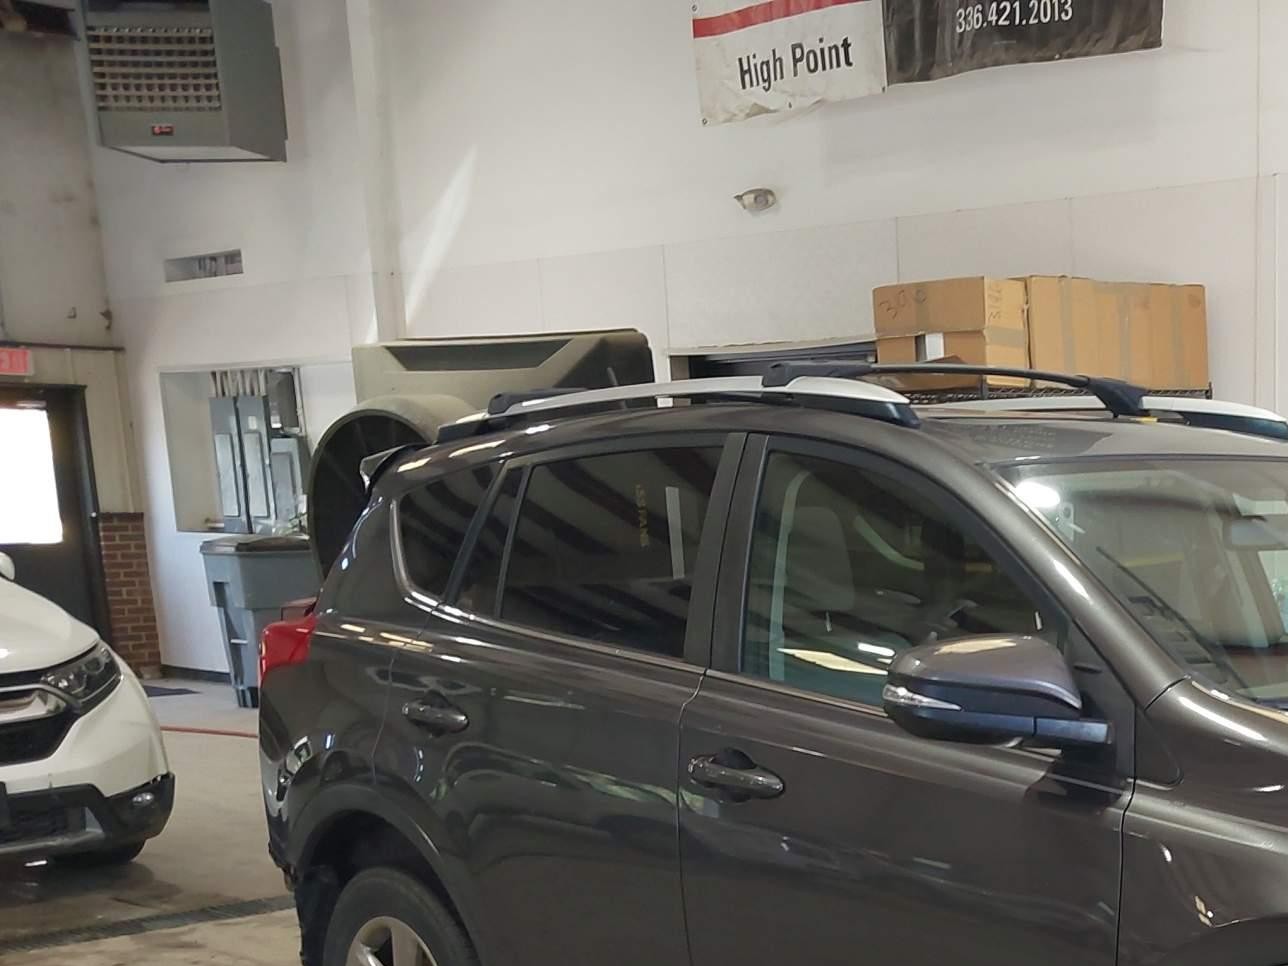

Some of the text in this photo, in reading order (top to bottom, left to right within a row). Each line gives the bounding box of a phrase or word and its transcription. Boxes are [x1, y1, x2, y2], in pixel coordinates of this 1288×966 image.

[955, 0, 1073, 33] 336.421.2013
[737, 36, 854, 92] High Point
